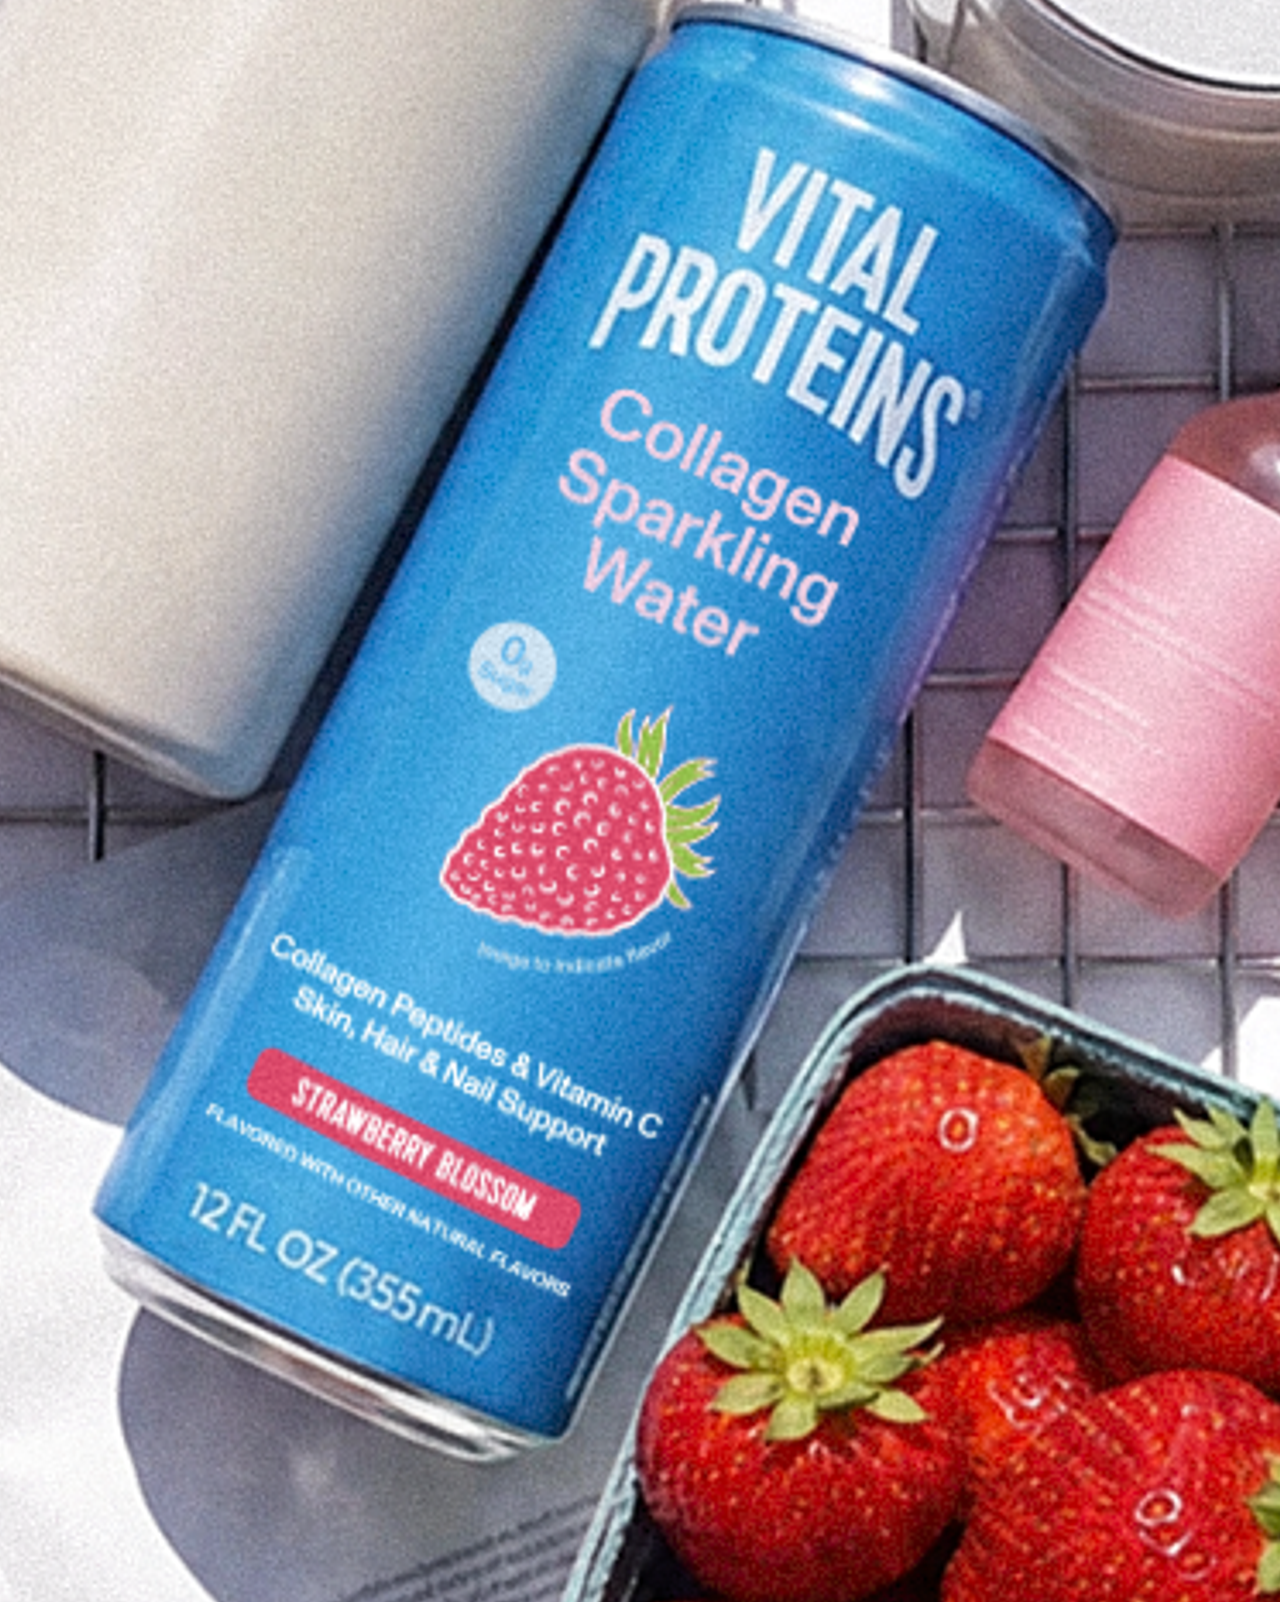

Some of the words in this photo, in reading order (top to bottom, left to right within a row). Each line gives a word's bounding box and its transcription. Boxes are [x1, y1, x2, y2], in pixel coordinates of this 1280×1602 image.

[737, 146, 939, 335] VITAL
[558, 449, 839, 627] Sparkling
[600, 389, 860, 546] Collagen
[581, 537, 759, 657] Water
[271, 933, 389, 1009] Collagen
[390, 991, 507, 1068] Peptides
[510, 1051, 531, 1081] &
[537, 1061, 634, 1129] Vitamin
[638, 1112, 664, 1139] C
[293, 984, 355, 1040] Skin,
[360, 1018, 418, 1064] Hair
[419, 1049, 441, 1079] &
[442, 1058, 498, 1104] Nail
[497, 1086, 607, 1157] Support
[189, 1181, 232, 1232] 12
[225, 1201, 267, 1254] FL
[276, 1228, 339, 1285] OZ
[205, 1102, 299, 1163] FLAVORED
[299, 1151, 346, 1187] WITH
[346, 1177, 407, 1219] OTHER
[406, 1208, 486, 1259] NATURAL
[487, 1249, 572, 1298] FLAVORS
[291, 1076, 437, 1169] STRAWBERRY
[434, 1149, 538, 1221] BLOSSOM
